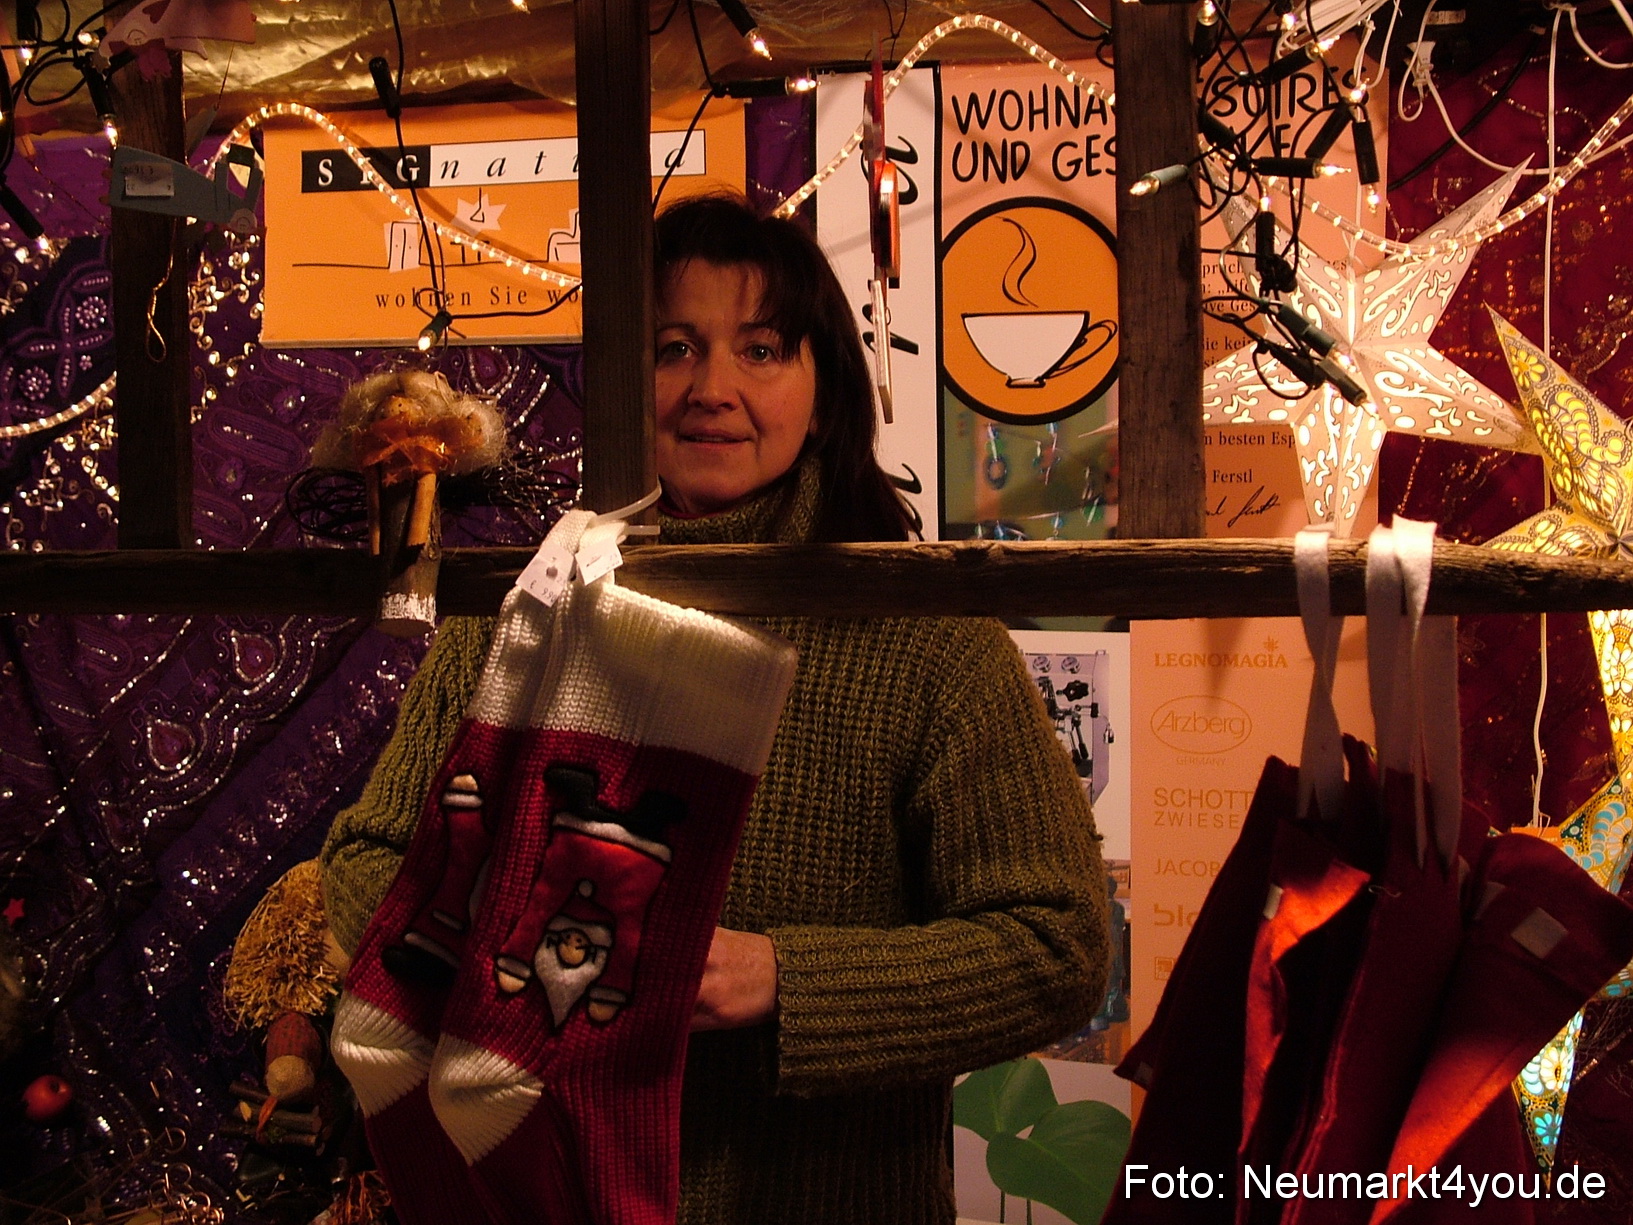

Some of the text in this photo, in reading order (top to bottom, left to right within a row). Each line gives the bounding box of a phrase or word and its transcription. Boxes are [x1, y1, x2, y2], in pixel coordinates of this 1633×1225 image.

[952, 140, 1031, 183] UND
[490, 286, 527, 304] Sie
[547, 286, 580, 305] wo
[1230, 298, 1256, 312] Ges
[1219, 431, 1265, 446] besten
[1271, 431, 1296, 449] Esp
[1213, 468, 1253, 483] Ferstl
[1154, 653, 1288, 669] LEGNOMAGIA
[1157, 710, 1246, 739] Arzberg
[1175, 755, 1227, 767] GERMANY
[1154, 787, 1254, 810] SCHOTT
[1154, 811, 1242, 829] ZWIESE
